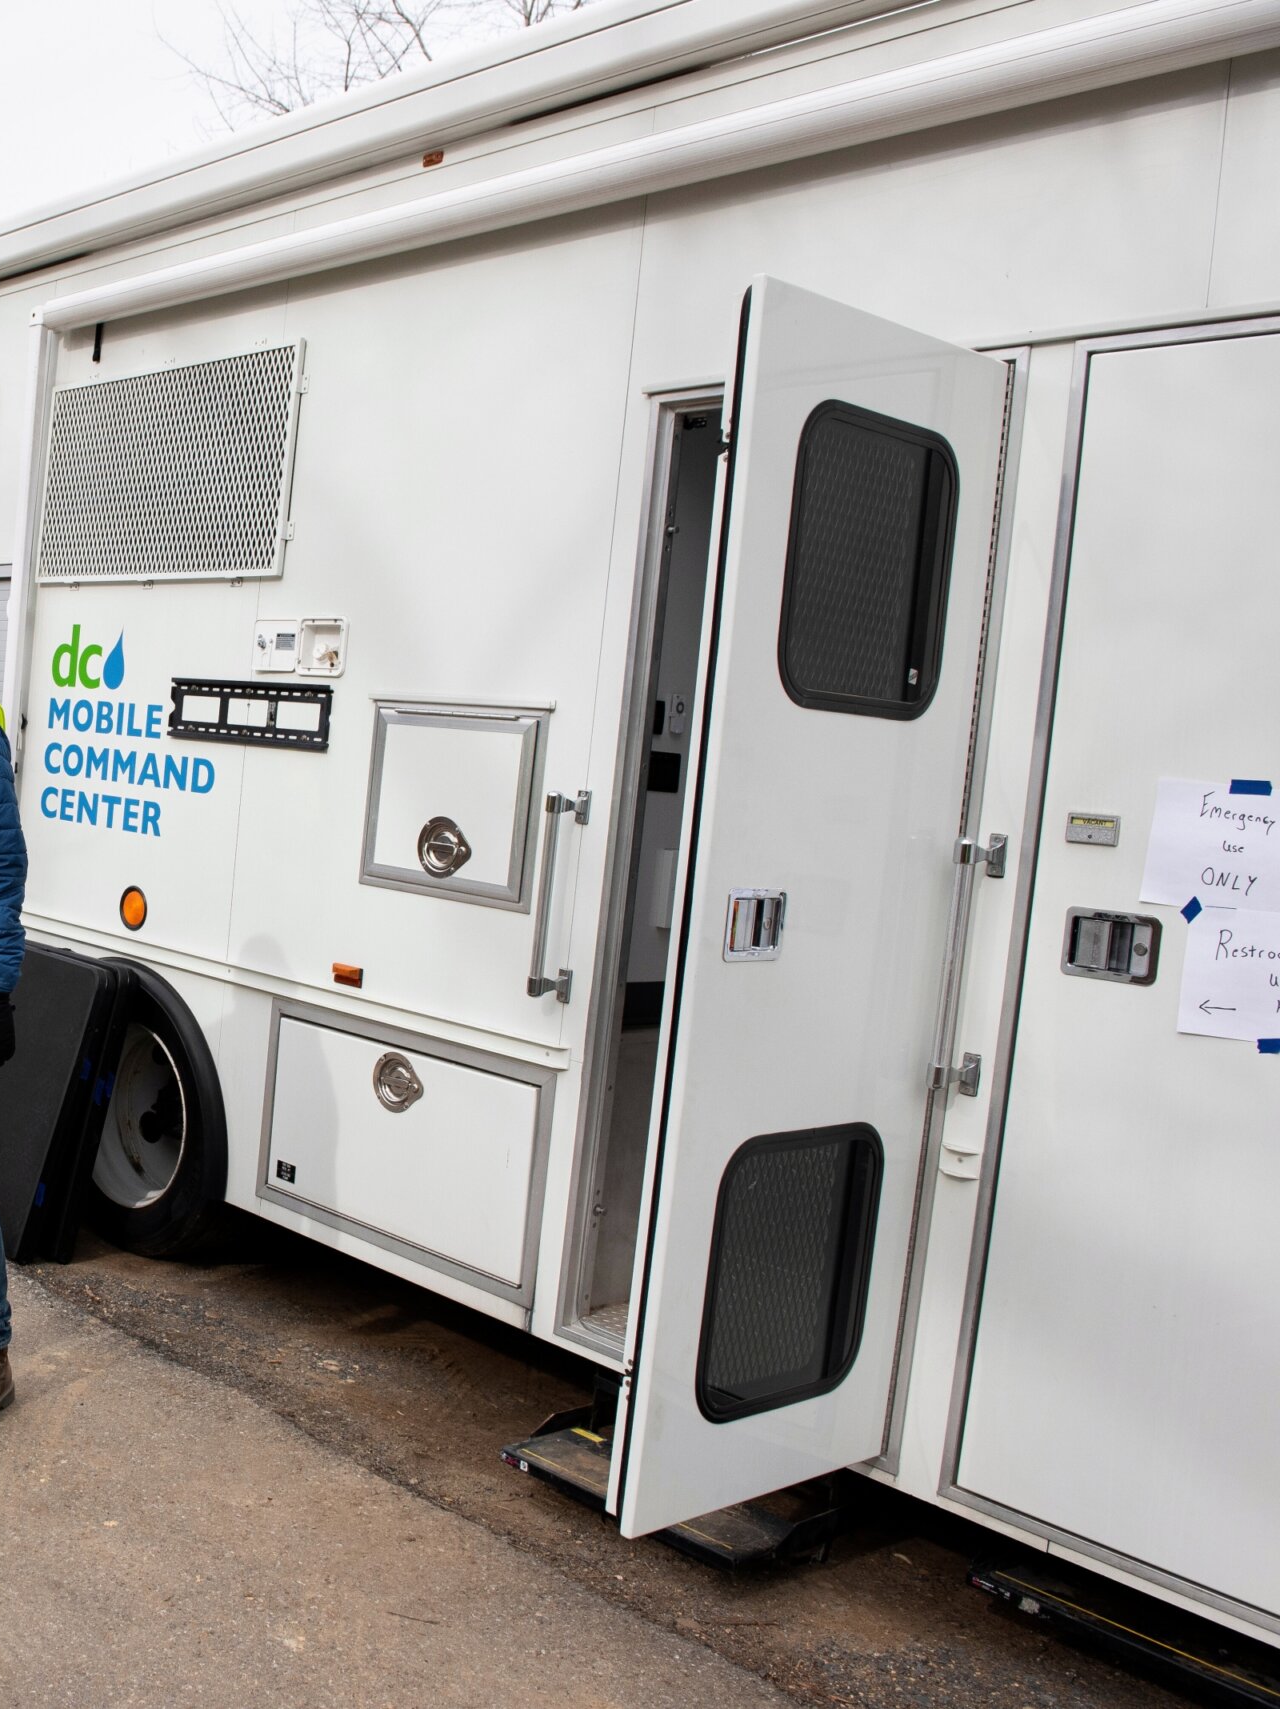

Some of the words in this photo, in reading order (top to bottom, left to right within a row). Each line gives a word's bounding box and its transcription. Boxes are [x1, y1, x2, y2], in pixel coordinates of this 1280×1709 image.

[52, 624, 103, 691] dc
[48, 697, 164, 739] MOBILE
[44, 742, 216, 795] COMMAND
[40, 786, 162, 837] CENTER
[1200, 791, 1276, 836] Emergency
[1201, 866, 1258, 896] ONLY
